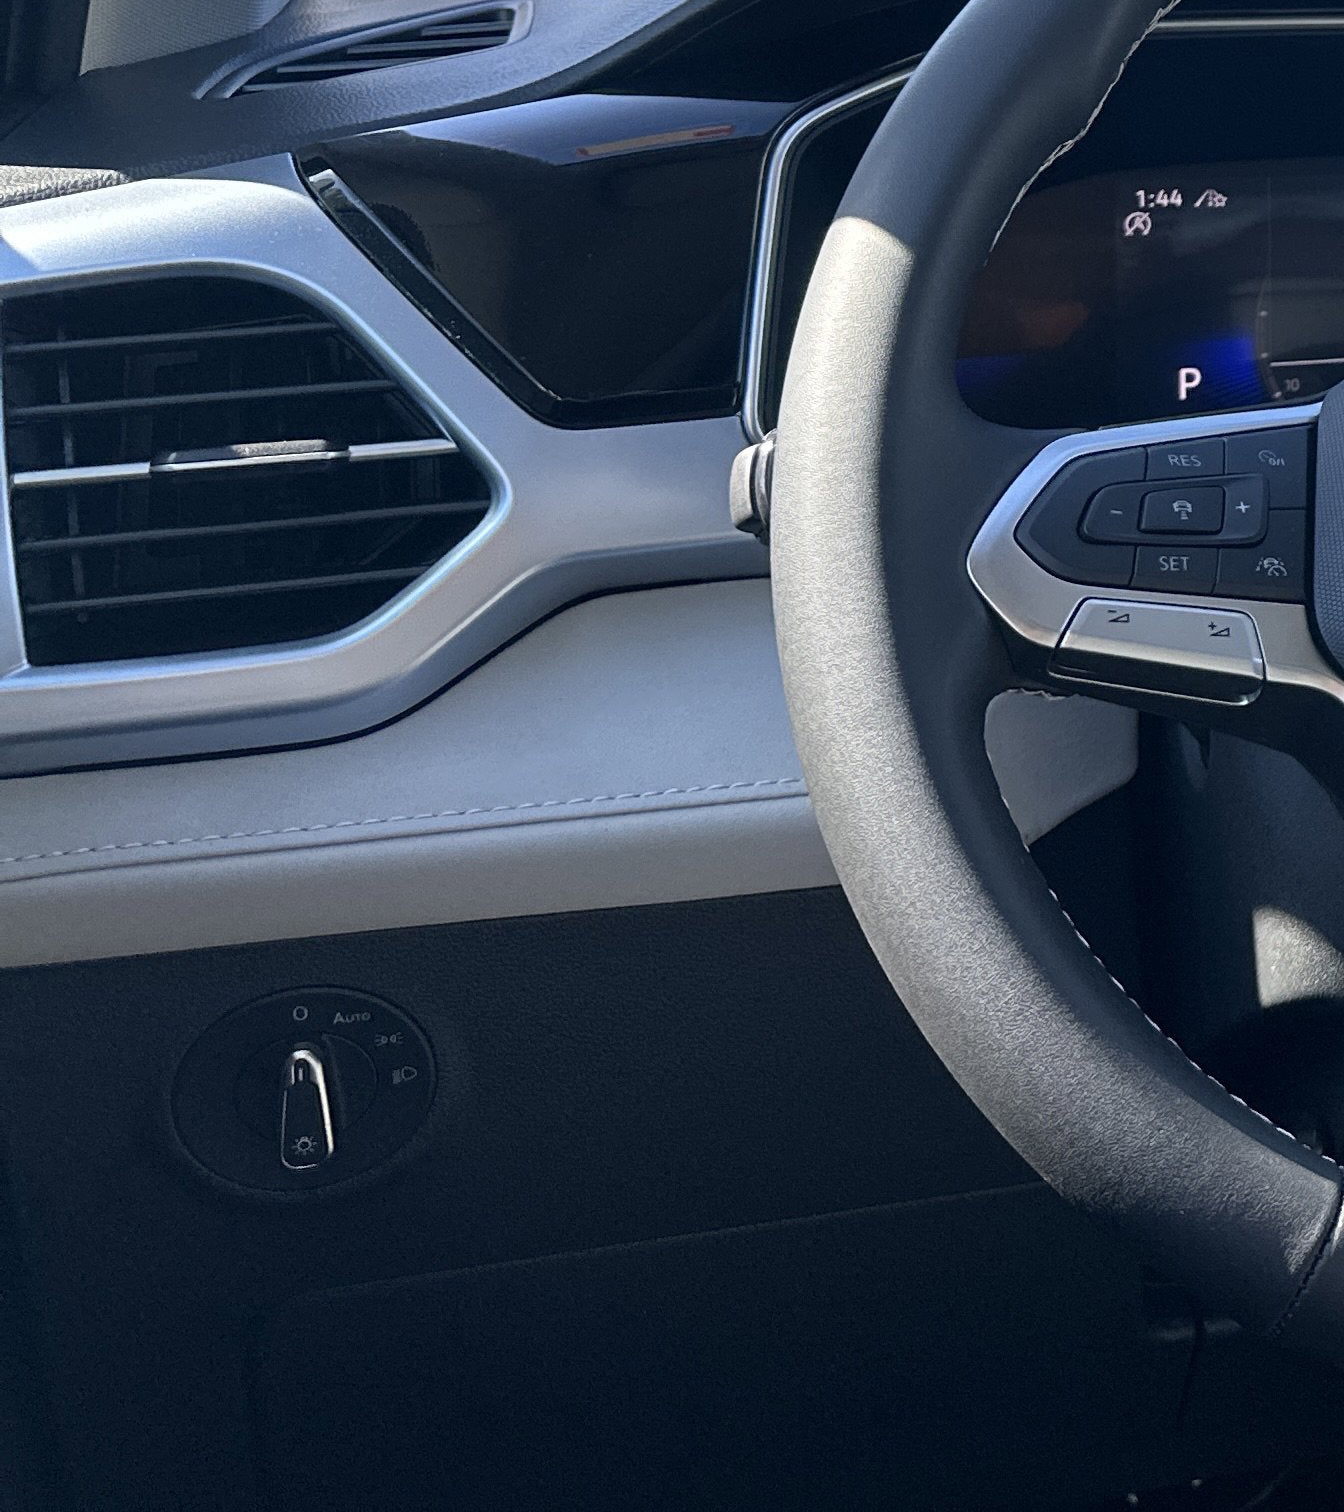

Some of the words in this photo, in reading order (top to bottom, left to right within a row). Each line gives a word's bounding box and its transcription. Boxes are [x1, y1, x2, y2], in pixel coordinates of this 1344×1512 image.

[1135, 188, 1184, 208] 1:44
[1178, 366, 1202, 401] P
[1167, 454, 1202, 468] RES
[1159, 555, 1191, 572] SET
